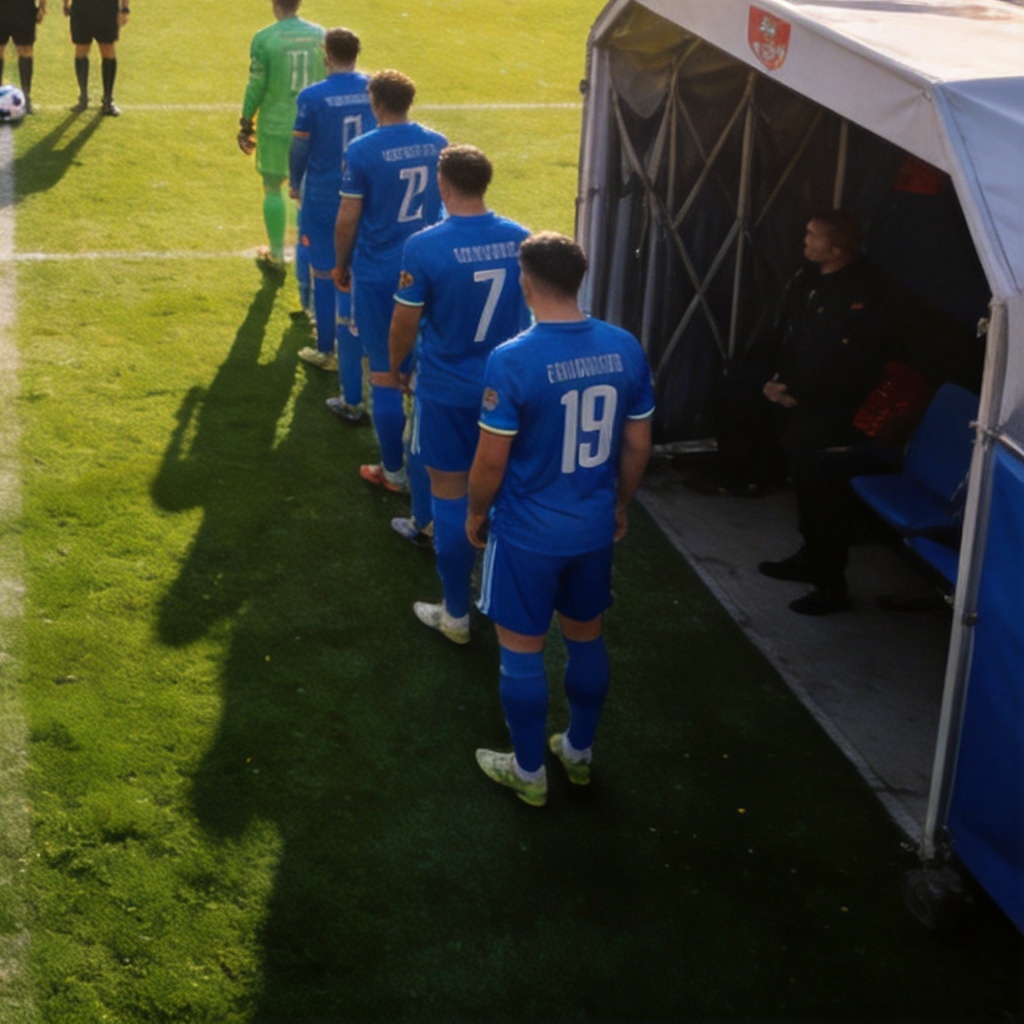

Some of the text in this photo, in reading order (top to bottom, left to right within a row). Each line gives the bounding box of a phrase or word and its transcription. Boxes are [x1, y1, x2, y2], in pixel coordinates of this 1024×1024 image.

[396, 165, 429, 223] 2
[473, 267, 507, 343] 7
[559, 383, 619, 474] 19
